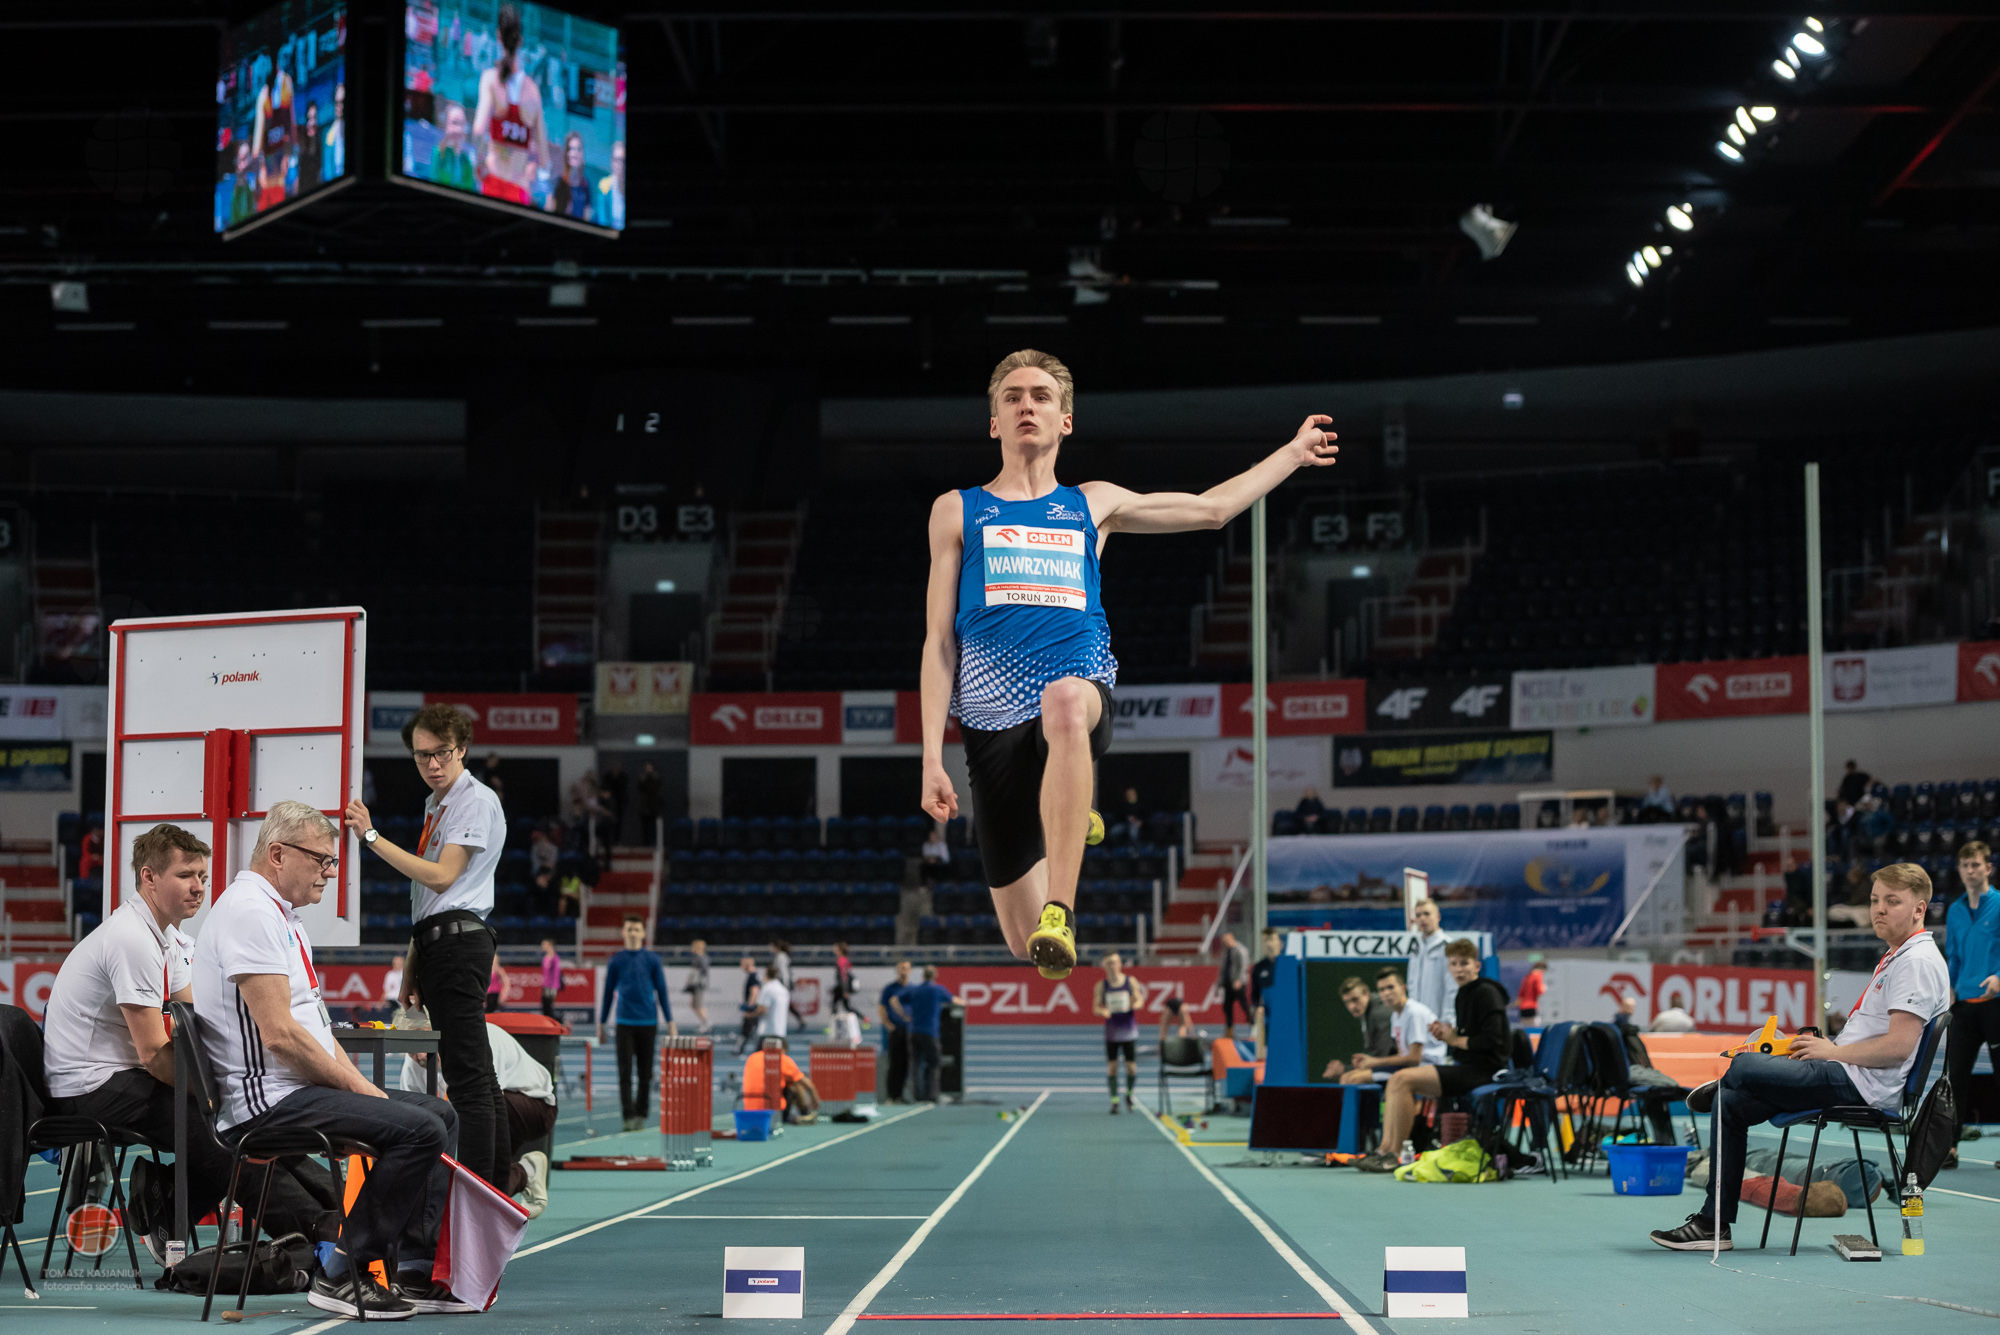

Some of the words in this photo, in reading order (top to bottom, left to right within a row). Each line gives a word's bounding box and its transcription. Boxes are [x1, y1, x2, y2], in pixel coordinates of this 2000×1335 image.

[617, 504, 658, 533] D3
[677, 504, 716, 533] E3
[1312, 513, 1349, 544] E3
[1366, 511, 1405, 541] F3
[1029, 533, 1071, 545] ORLEN
[988, 556, 1082, 581] WAWRZYNIAK
[1007, 592, 1041, 603] TORUŃ
[1044, 594, 1068, 604] 2019
[221, 670, 260, 686] polanik
[1730, 676, 1789, 696] ORLEN
[1112, 697, 1170, 718] OVE
[1287, 699, 1345, 717] ORLEN
[1376, 687, 1429, 720] 4F
[1450, 685, 1504, 718] 4F
[494, 710, 554, 725] ORLEN
[759, 709, 818, 725] ORLEN
[1319, 935, 1421, 955] TYCZKA
[959, 982, 1079, 1014] PZLA
[1138, 981, 1226, 1013] ZLA
[1658, 974, 1807, 1029] ORLEN
